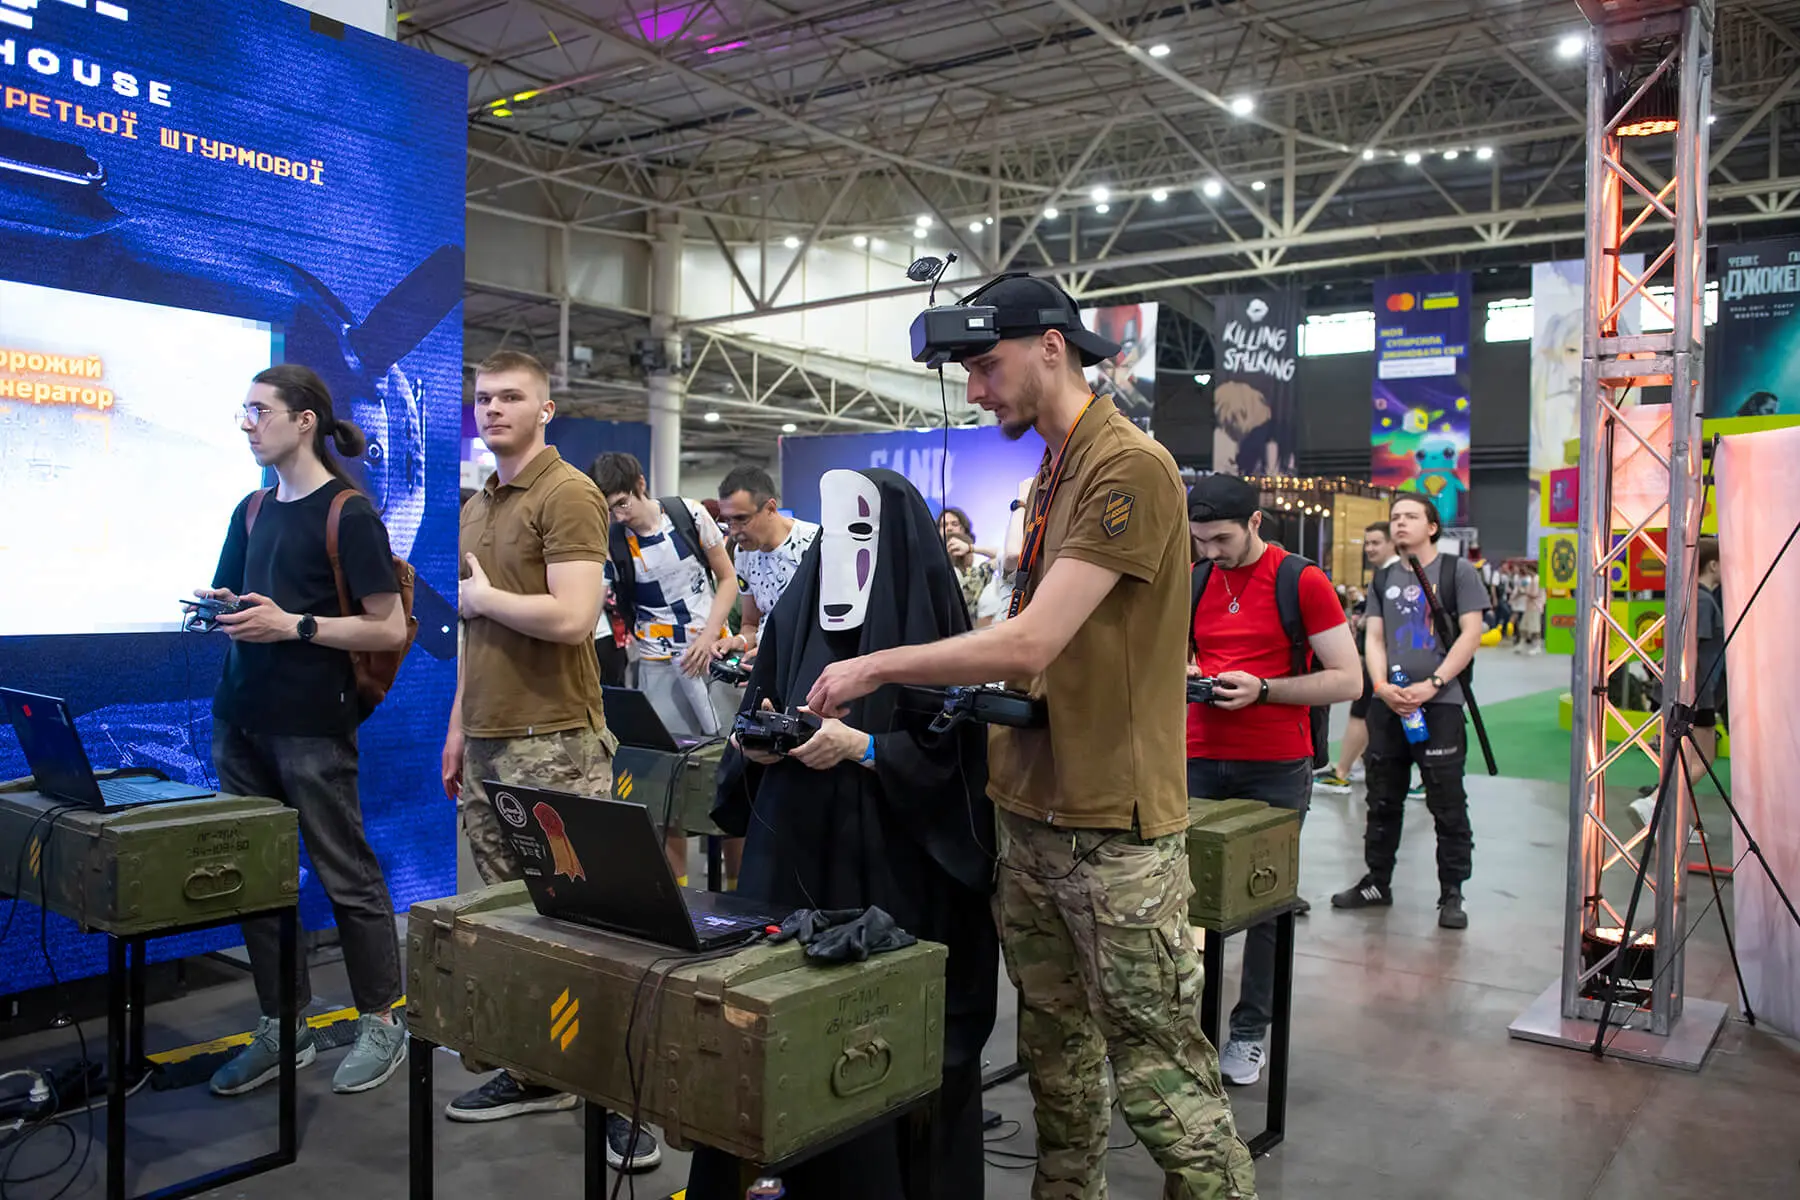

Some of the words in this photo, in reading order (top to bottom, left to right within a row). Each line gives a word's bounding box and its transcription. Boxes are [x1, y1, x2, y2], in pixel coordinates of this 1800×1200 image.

[0, 84, 138, 140] РЕТЬОЇ
[160, 126, 325, 186] ШТУРМОВОЇ
[1222, 320, 1287, 352] KILLING
[1223, 348, 1295, 381] STALKING
